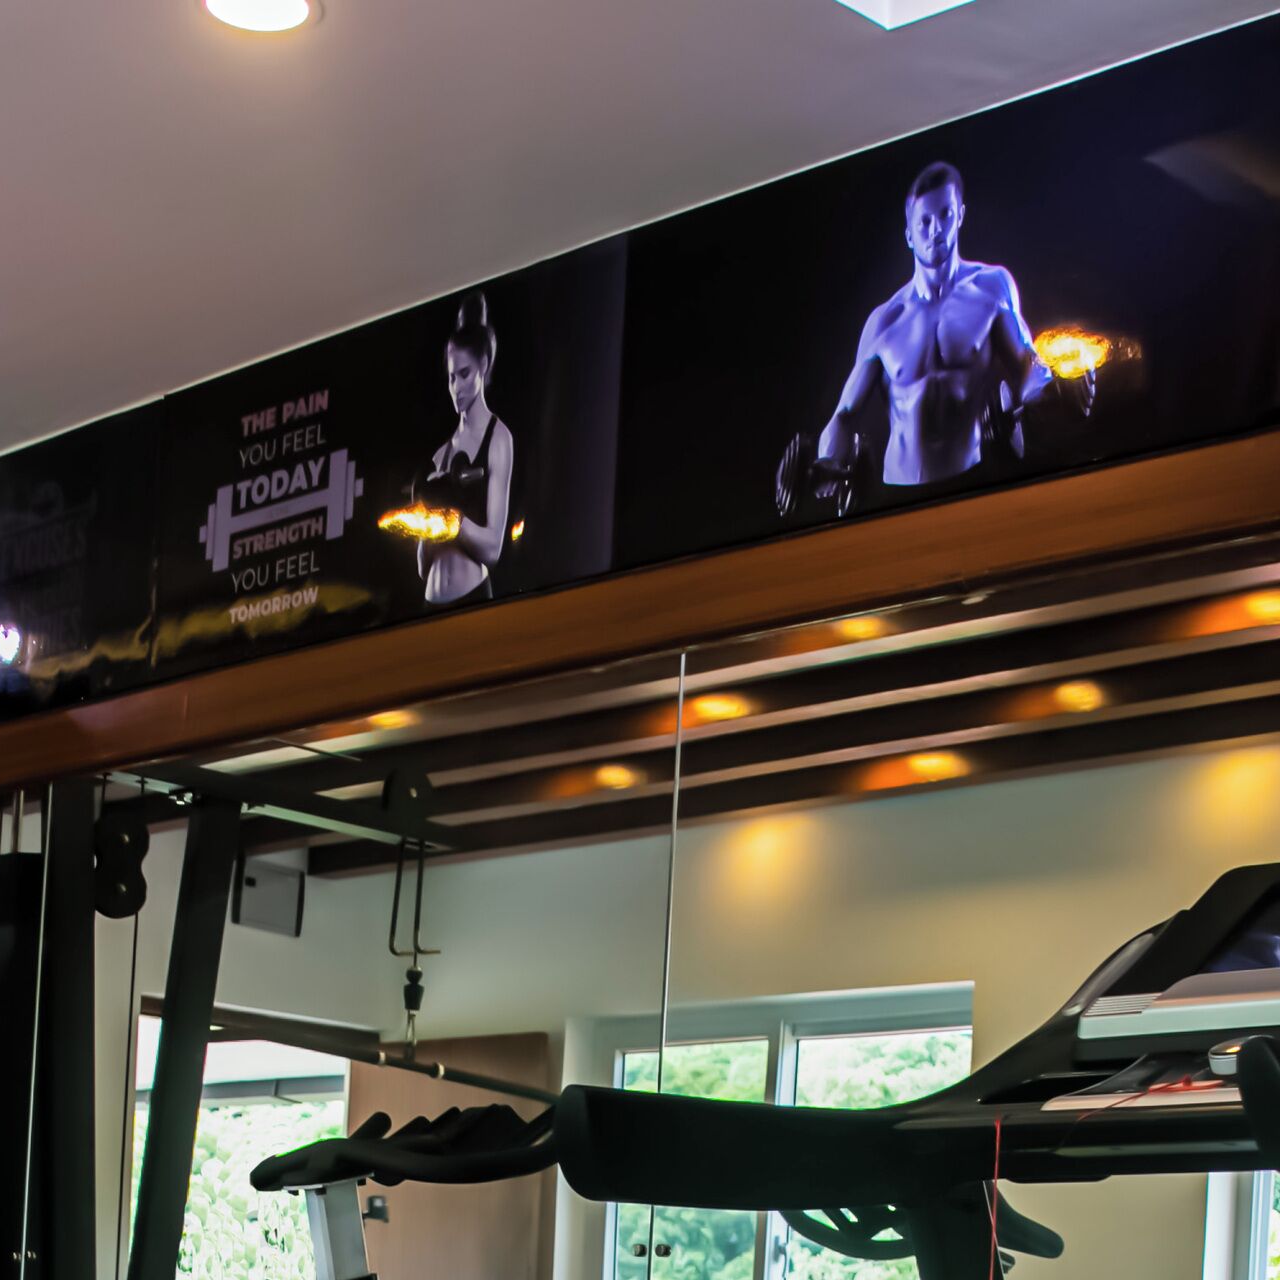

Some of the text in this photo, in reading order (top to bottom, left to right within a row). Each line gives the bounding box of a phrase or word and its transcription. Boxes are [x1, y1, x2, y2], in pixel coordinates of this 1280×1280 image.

[241, 389, 329, 438] THE PAIN
[239, 424, 327, 469] YOU FEEL
[236, 456, 326, 509] TODAY
[232, 516, 324, 560] STRENGTH
[231, 550, 320, 595] YOU FEEL
[229, 585, 319, 625] TOMORROW
